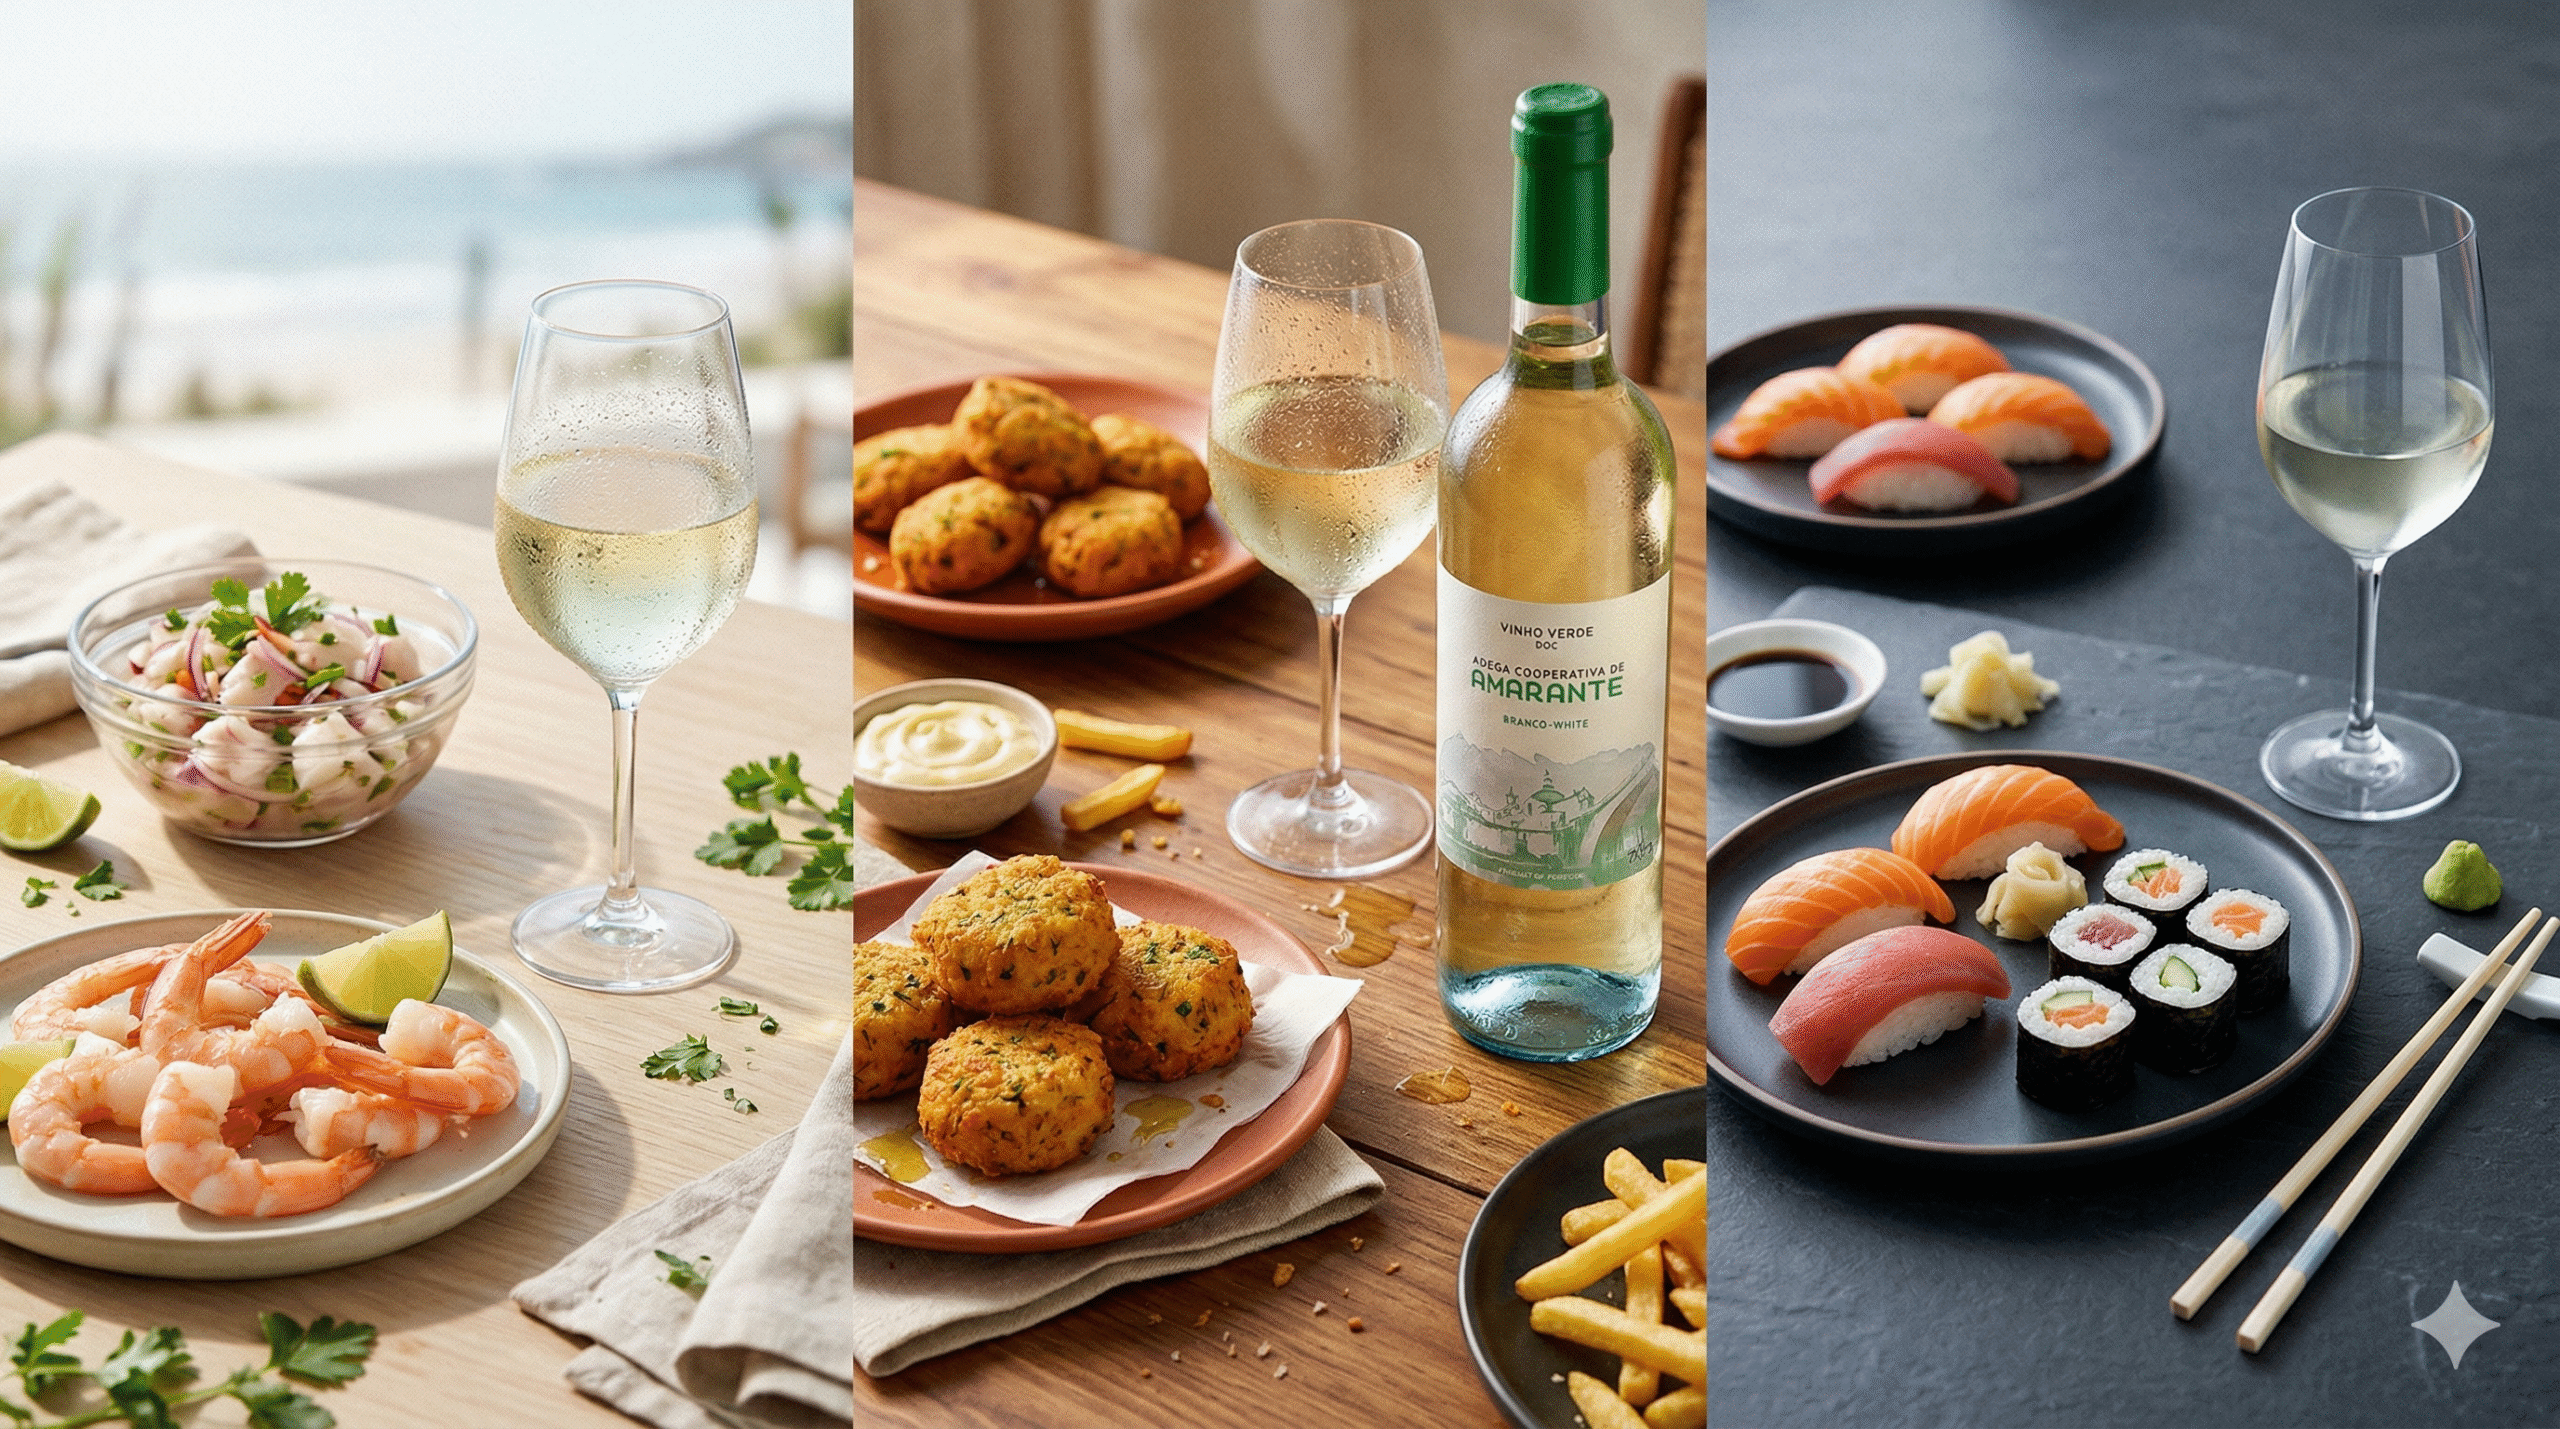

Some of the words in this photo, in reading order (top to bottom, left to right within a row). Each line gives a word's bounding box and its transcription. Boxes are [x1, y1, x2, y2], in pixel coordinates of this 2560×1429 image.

[1500, 622, 1543, 638] VINHO
[1547, 626, 1594, 639] VERDE
[1535, 640, 1558, 650] DOC
[1472, 656, 1510, 674] ADEGA
[1514, 666, 1606, 680] COOPERATIVA
[1610, 661, 1625, 674] DE
[1471, 668, 1624, 704] AMARANTE
